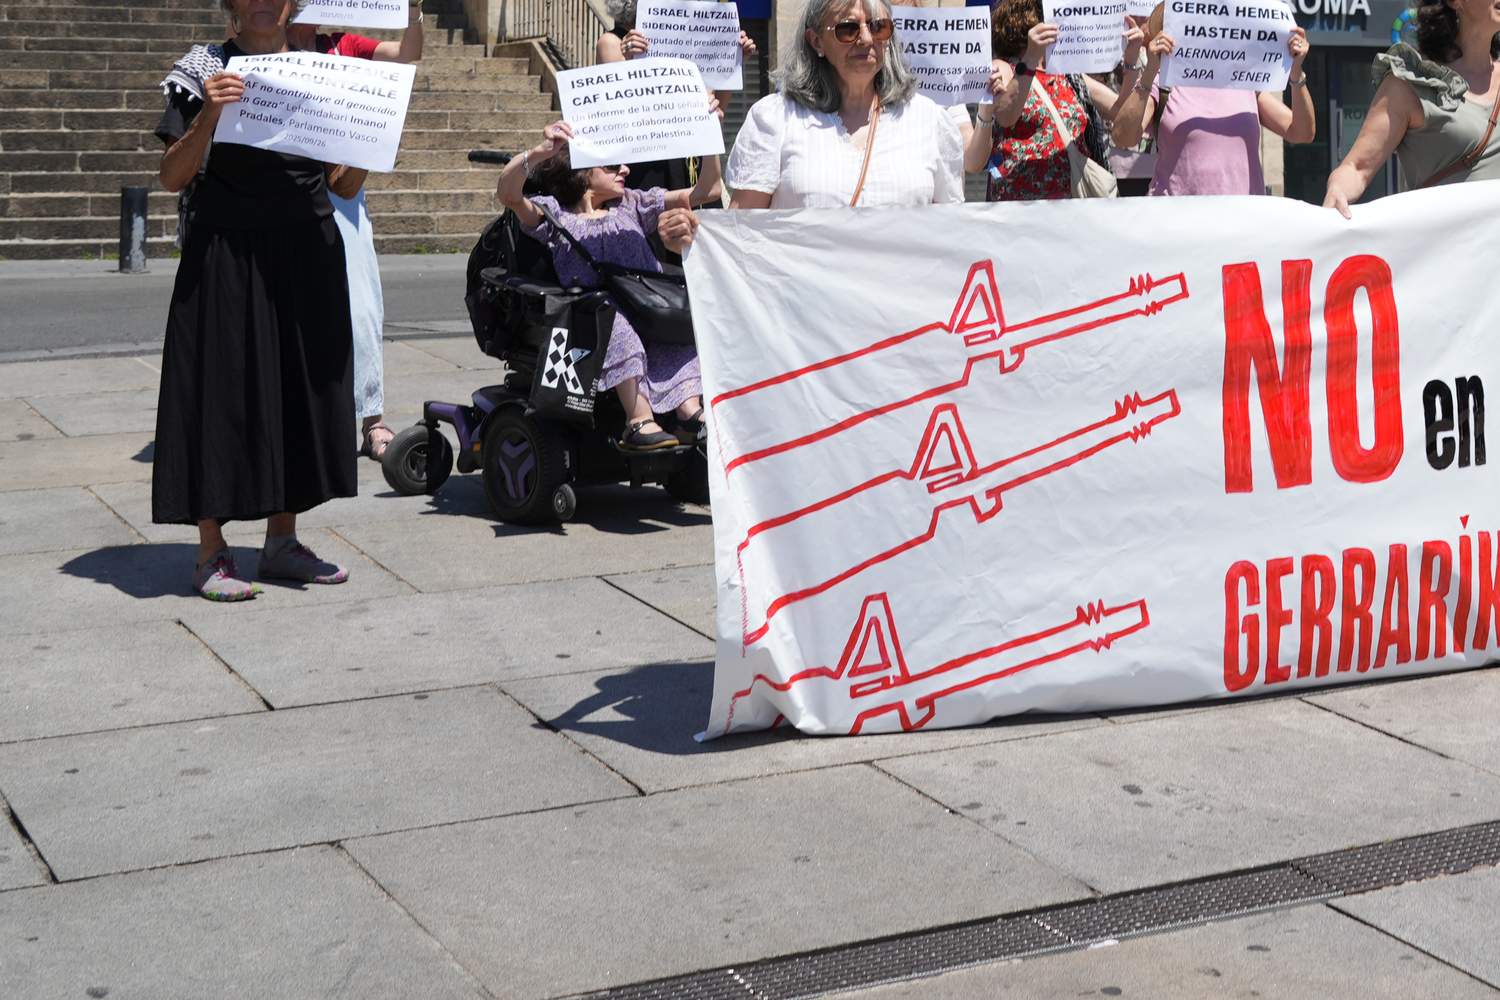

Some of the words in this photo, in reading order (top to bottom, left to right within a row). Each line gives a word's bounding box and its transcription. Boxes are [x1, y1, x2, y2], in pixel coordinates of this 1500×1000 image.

[346, 0, 358, 8] de
[361, 0, 401, 12] Defensa
[1172, 1, 1230, 17] GERRA
[1235, 6, 1290, 21] HEMEN
[320, 12, 354, 20] 2025/01/15
[648, 7, 690, 18] ISRAEL
[693, 10, 738, 20] HILTZAILE
[642, 22, 686, 32] SIDENOR
[688, 24, 741, 34] LAGUNTZAILE
[893, 18, 939, 31] ERRA
[944, 18, 988, 31] HEMEN
[1058, 24, 1094, 32] Gobierno
[1065, 36, 1076, 44] de
[1184, 25, 1252, 40] HASTEN
[1256, 30, 1278, 42] DA
[646, 37, 684, 46] mputado
[694, 40, 730, 48] presidente
[901, 42, 960, 55] ASTEN
[965, 42, 982, 54] DA
[694, 52, 736, 61] complicidad
[1052, 48, 1094, 56] Inversiones
[1174, 47, 1246, 61] AERNNOVA
[1262, 52, 1283, 63] ITP
[244, 56, 306, 66] ISRAEL
[312, 60, 400, 82] HILTZAILE
[716, 65, 734, 73] Gaza.
[910, 66, 962, 76] empresas
[965, 66, 992, 74] vascas
[1182, 68, 1214, 80] SAPA
[1230, 70, 1272, 83] SENER
[278, 68, 398, 100] LAGUNTZAILE
[570, 74, 624, 89] ISRAEL
[628, 67, 695, 80] HILTZAILE
[918, 81, 960, 93] ducción
[961, 80, 988, 92] militar
[242, 80, 259, 90] AF
[260, 84, 274, 94] no
[276, 86, 332, 104] contribuye
[334, 97, 344, 106] al
[346, 100, 397, 116] genocidio
[572, 94, 601, 107] CAF
[605, 84, 702, 102] LAGUNTZAILE
[239, 96, 250, 104] en
[286, 103, 348, 122] Lehendakari
[350, 115, 387, 130] Imanol
[572, 114, 586, 124] Un
[588, 108, 625, 120] informe
[628, 106, 638, 114] de
[642, 104, 650, 112] la
[653, 102, 675, 112] ONU
[677, 100, 705, 110] señala
[239, 109, 286, 128] Pradales,
[288, 118, 346, 138] Parlamento
[349, 130, 378, 144] Vasco
[582, 124, 601, 135] CAF
[602, 122, 629, 132] como
[632, 115, 692, 128] colaboradora
[694, 114, 710, 122] con
[284, 132, 326, 148] 2025/09/26
[650, 129, 694, 140] Palestina.
[630, 144, 667, 154] 2025/07/02
[1220, 253, 1405, 494] NO
[1422, 375, 1487, 470] en
